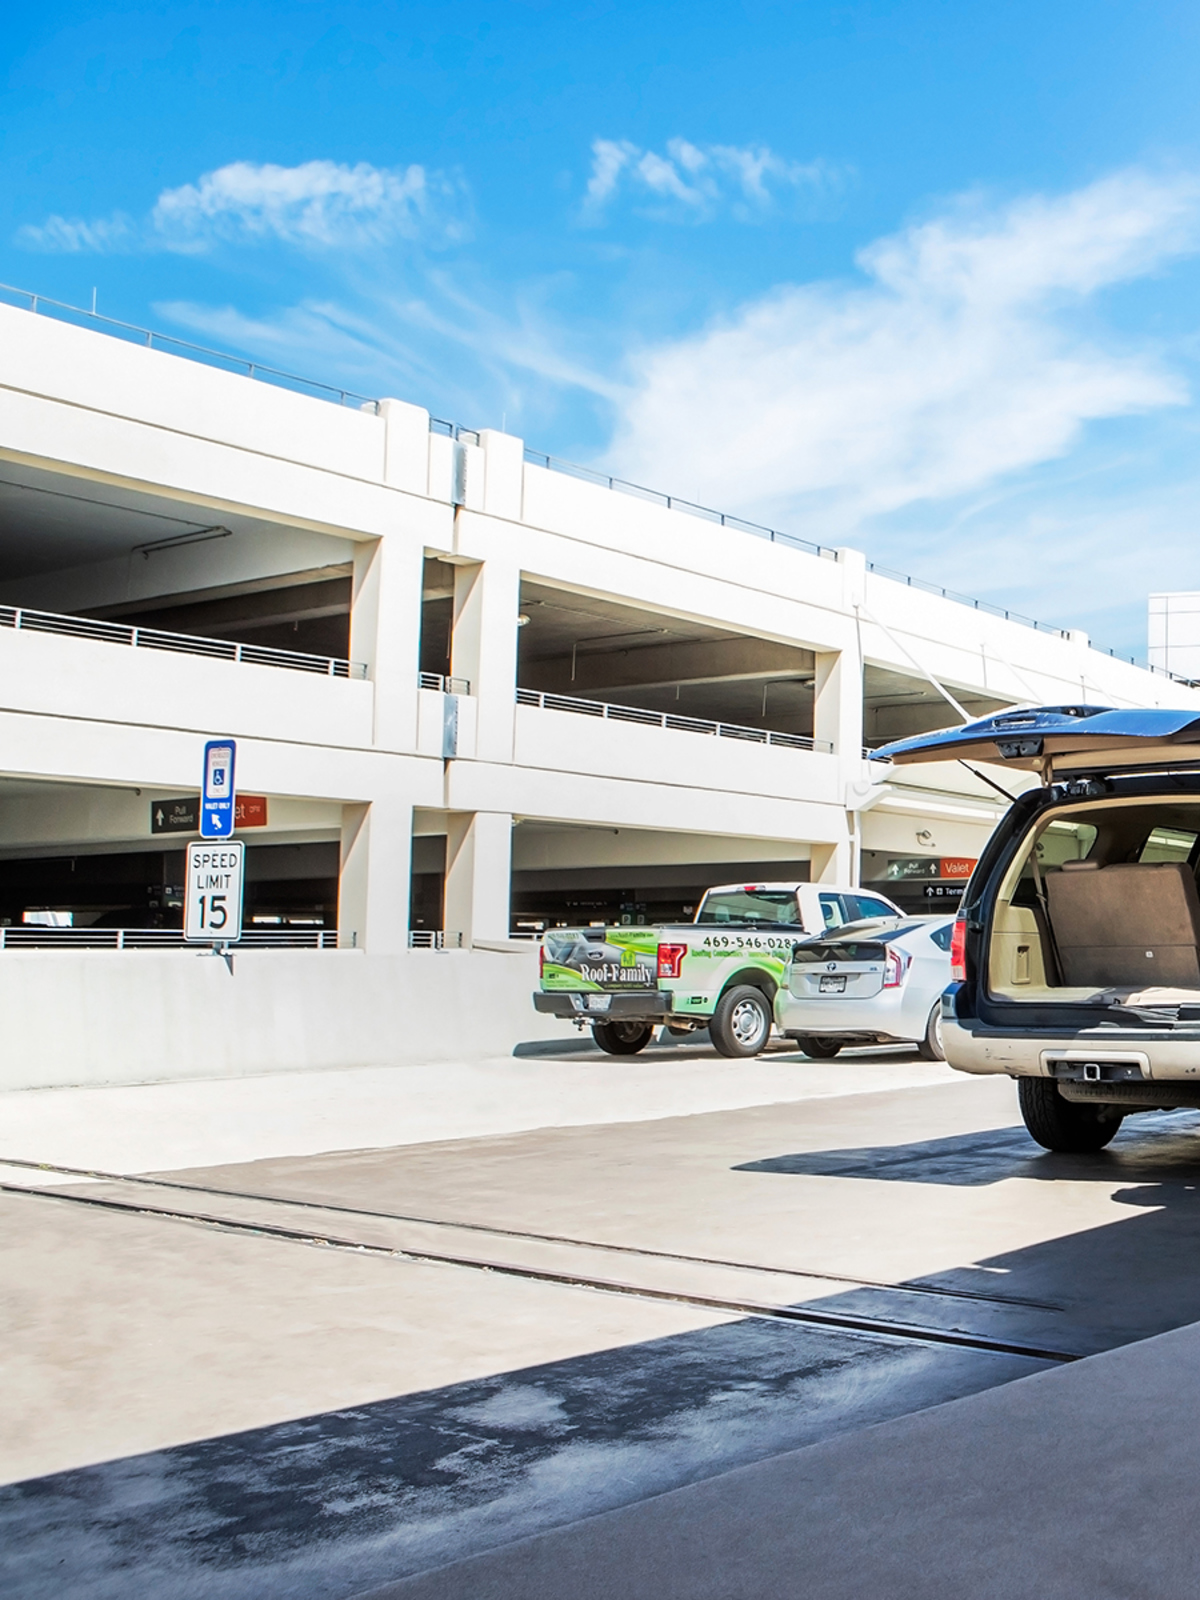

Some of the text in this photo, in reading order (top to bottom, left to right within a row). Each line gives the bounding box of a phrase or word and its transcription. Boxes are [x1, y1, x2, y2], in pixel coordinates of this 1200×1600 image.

[193, 853, 238, 869] SPEED
[945, 863, 969, 873] Valet
[197, 874, 232, 890] LIMIT
[945, 887, 965, 896] Term
[198, 895, 228, 929] 15
[580, 963, 654, 987] Roof-Family
